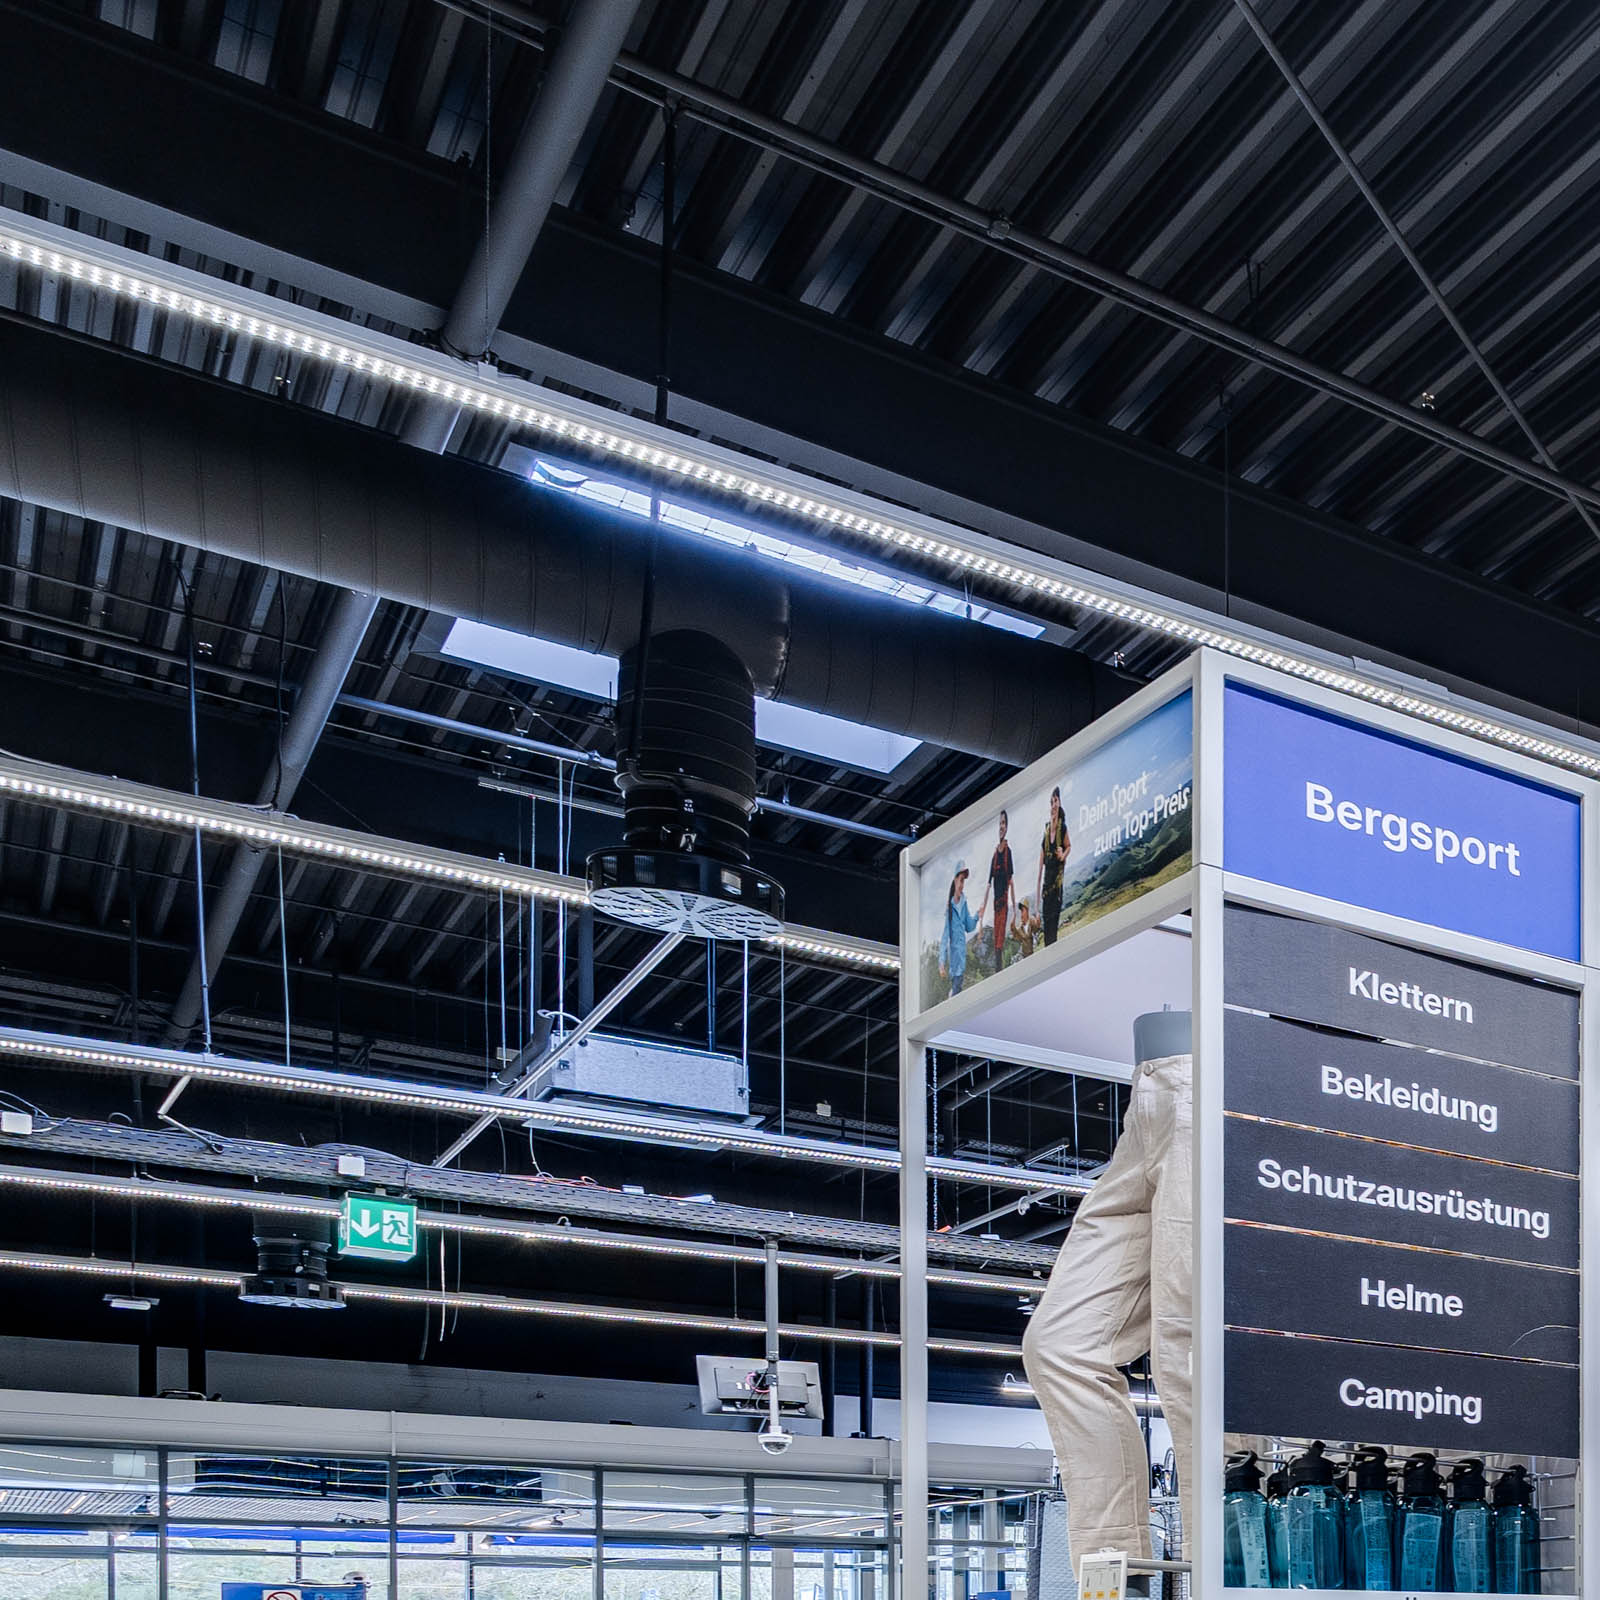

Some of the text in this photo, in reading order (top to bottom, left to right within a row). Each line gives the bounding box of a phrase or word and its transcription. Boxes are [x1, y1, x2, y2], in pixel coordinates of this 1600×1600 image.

[1079, 771, 1149, 833] Dein Sport
[1094, 784, 1190, 857] zum Top-Preis
[1305, 780, 1523, 878] Bergsport
[1348, 967, 1475, 1024] Klettern
[1320, 1064, 1499, 1133] Bekleidung
[1257, 1157, 1552, 1239] Schutzausrüstung
[1360, 1277, 1464, 1317] Helme
[1339, 1378, 1482, 1425] Camping
